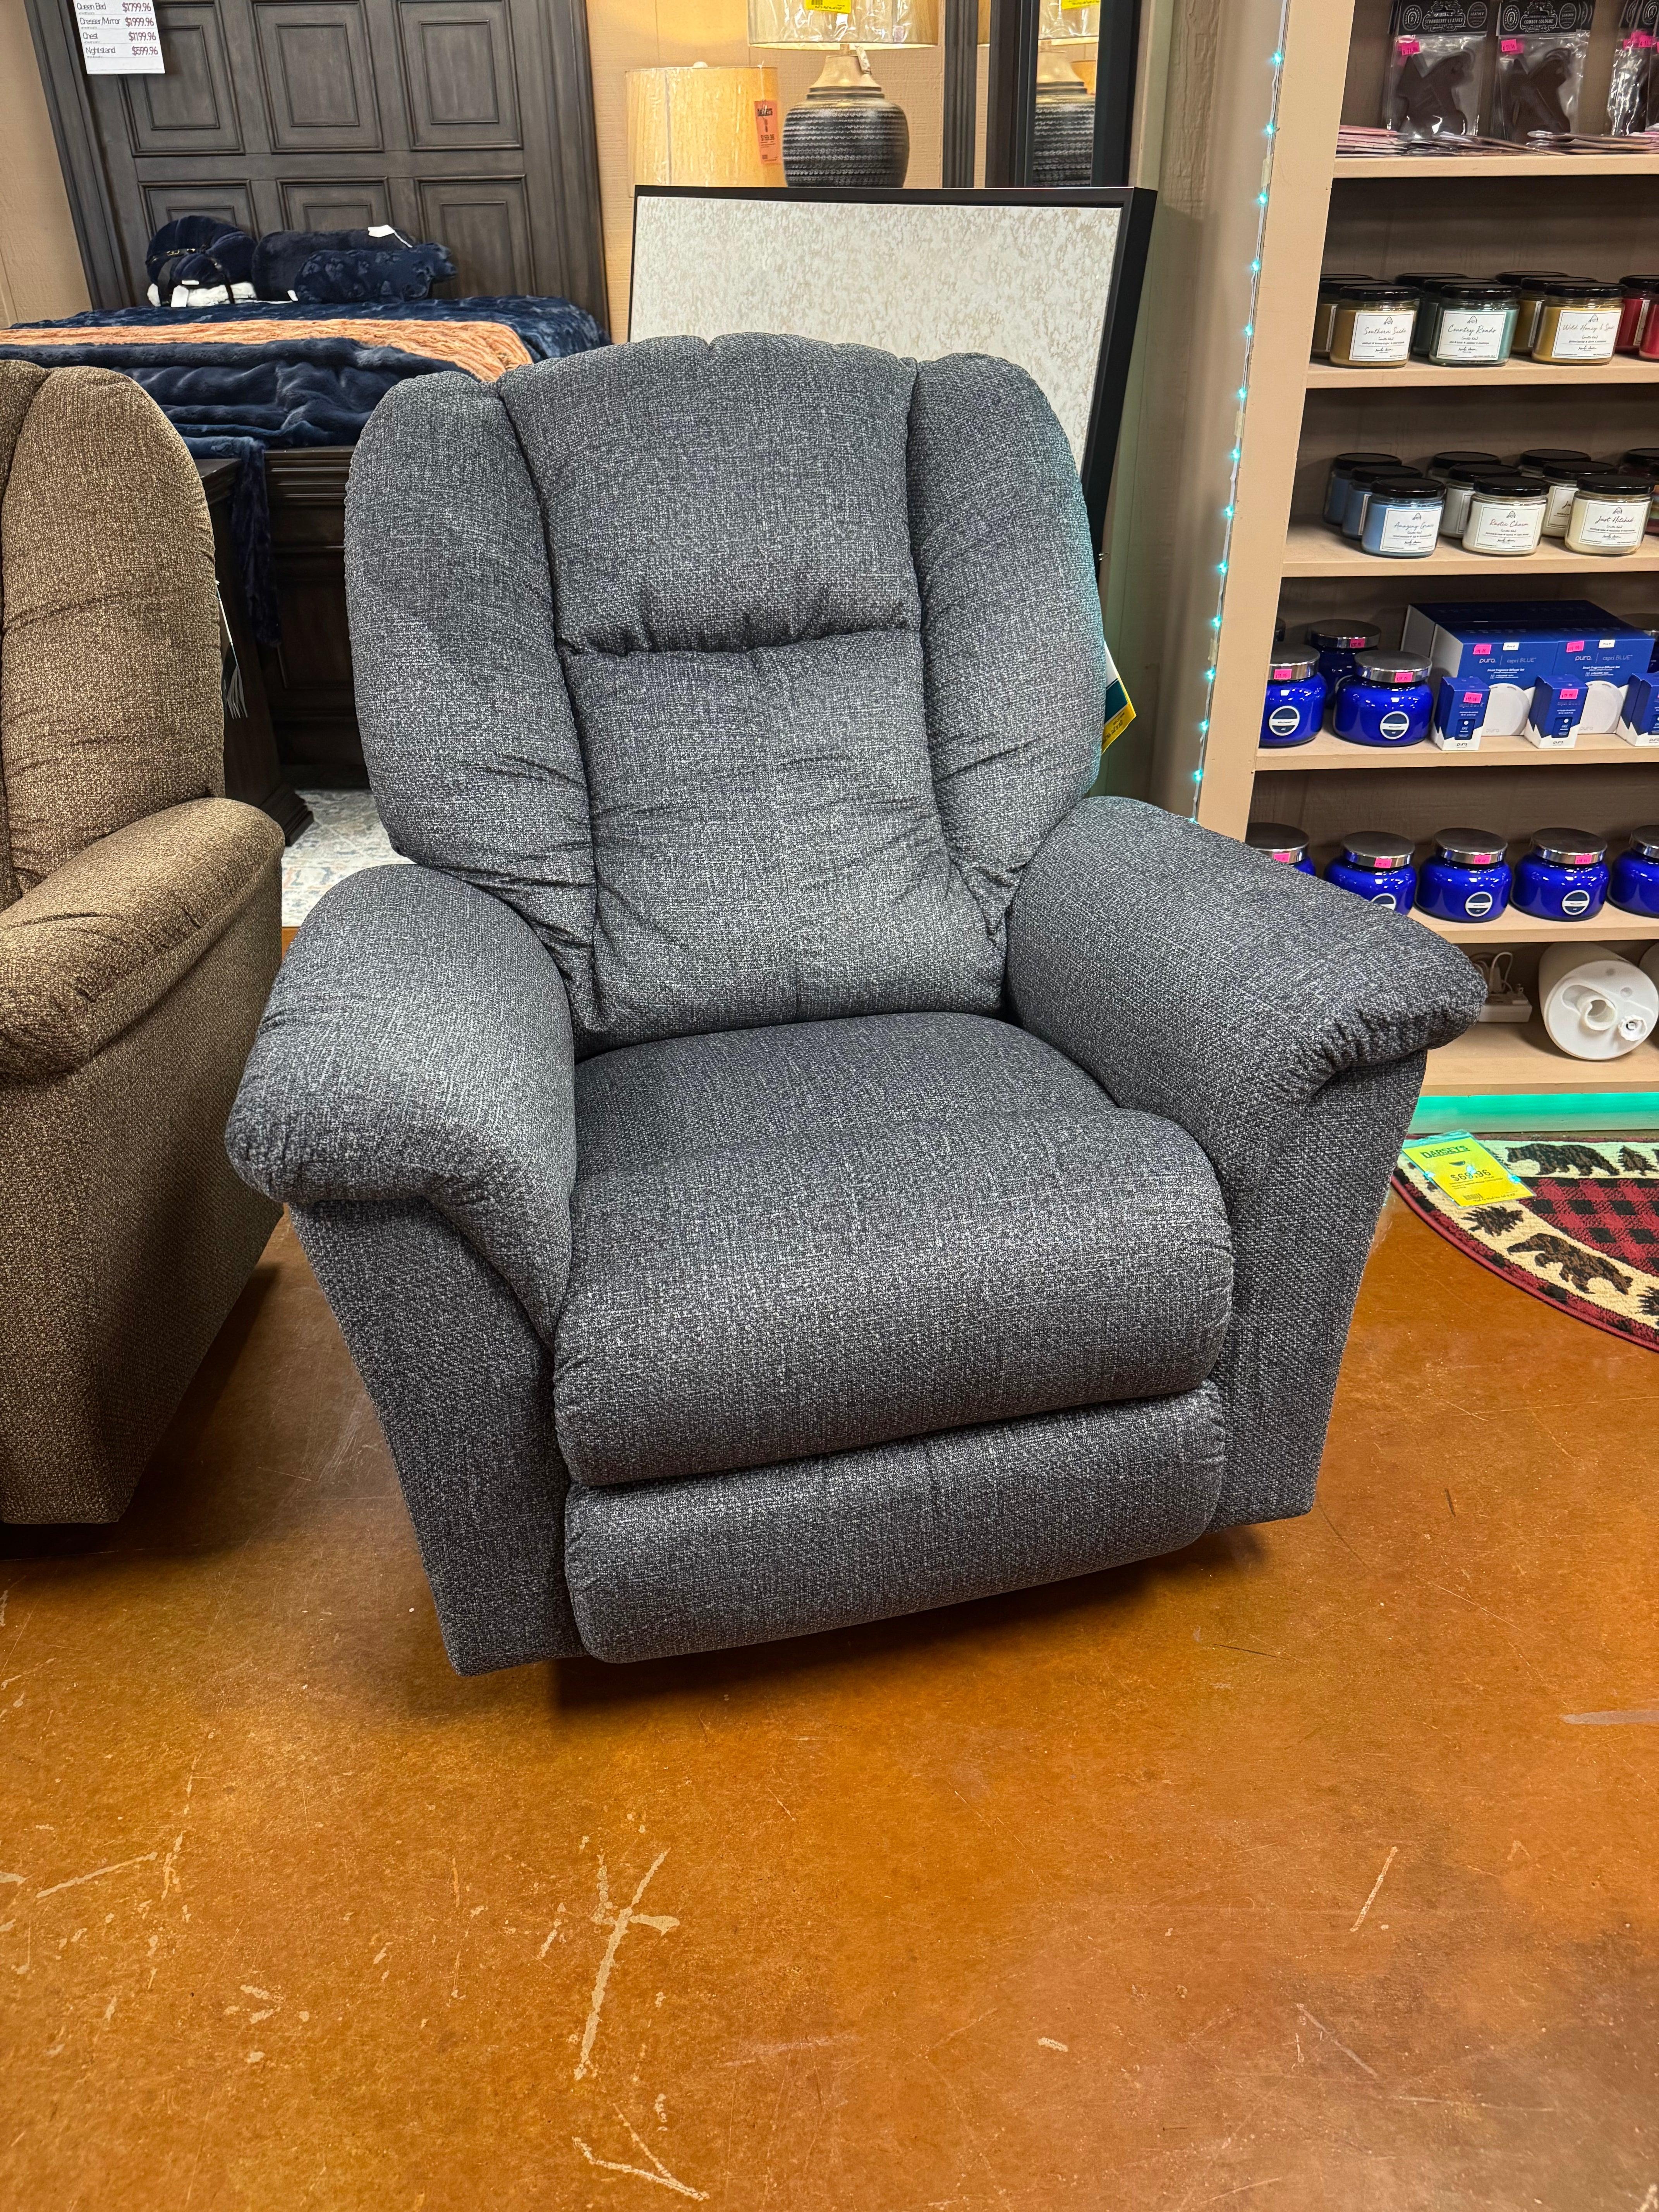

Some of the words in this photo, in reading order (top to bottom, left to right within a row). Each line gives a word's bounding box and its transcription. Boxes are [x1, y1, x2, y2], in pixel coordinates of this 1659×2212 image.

[122, 2, 151, 12] $1799.96
[80, 17, 120, 26] Dresser/Mirror
[125, 17, 154, 27] $1999.96
[128, 31, 156, 41] $1199.96
[86, 46, 116, 55] Nightstand
[132, 46, 158, 56] $599.96
[1448, 324, 1474, 336] Country
[1476, 325, 1496, 333] Roads
[1580, 324, 1598, 333] Honey
[1595, 516, 1611, 524] Just
[1612, 515, 1634, 524] Hitched
[1395, 522, 1419, 530] Amazing
[1420, 1145, 1470, 1158] DARSEYS
[1450, 1169, 1491, 1181] $69.96
